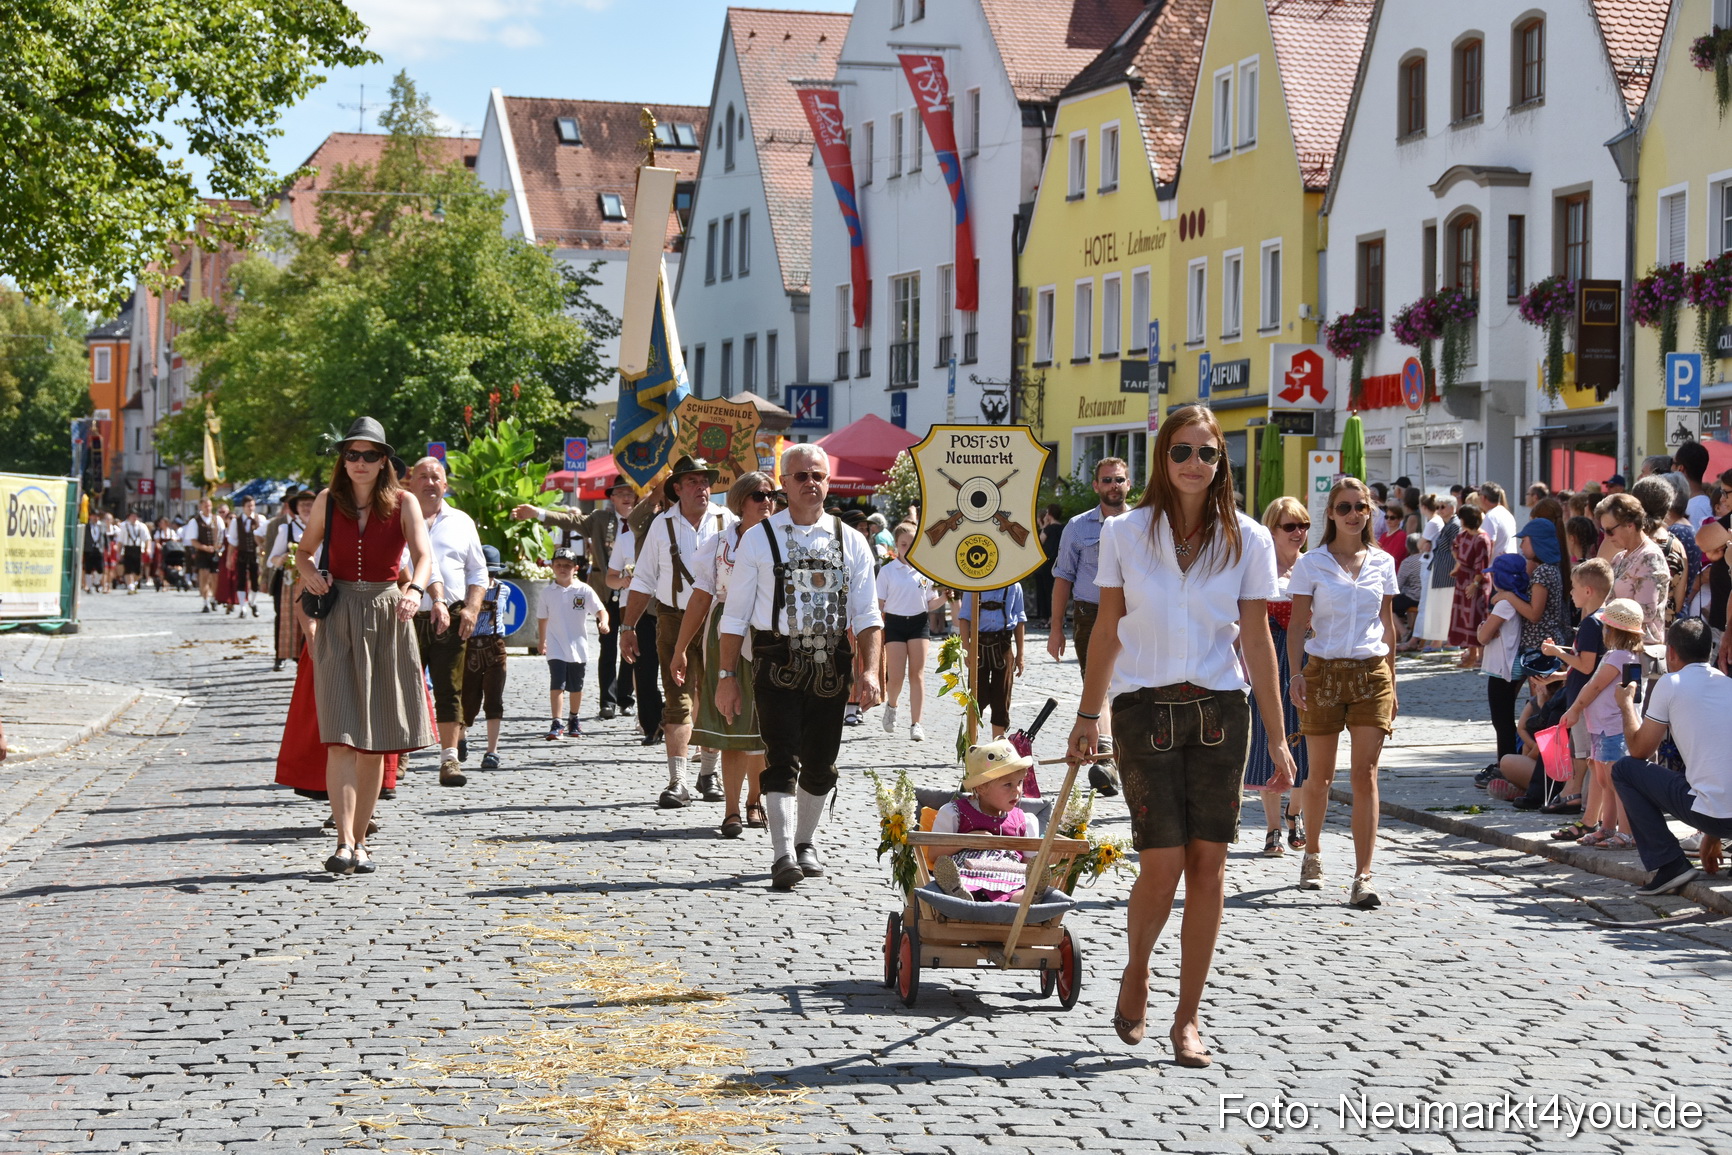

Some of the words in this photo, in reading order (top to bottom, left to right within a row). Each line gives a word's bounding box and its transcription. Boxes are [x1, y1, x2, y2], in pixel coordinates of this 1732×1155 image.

[1084, 232, 1118, 267] HOTEL
[1127, 226, 1167, 256] Lehmeier
[1123, 379, 1166, 389] TAIFN
[1201, 360, 1208, 392] P
[1210, 364, 1241, 386] AIFUN
[1674, 360, 1693, 400] P
[687, 403, 752, 419] SCHÜTZENGILDE
[1078, 396, 1126, 419] Restaurant
[566, 461, 585, 469] TAXI
[945, 451, 1013, 464] Neumarkt
